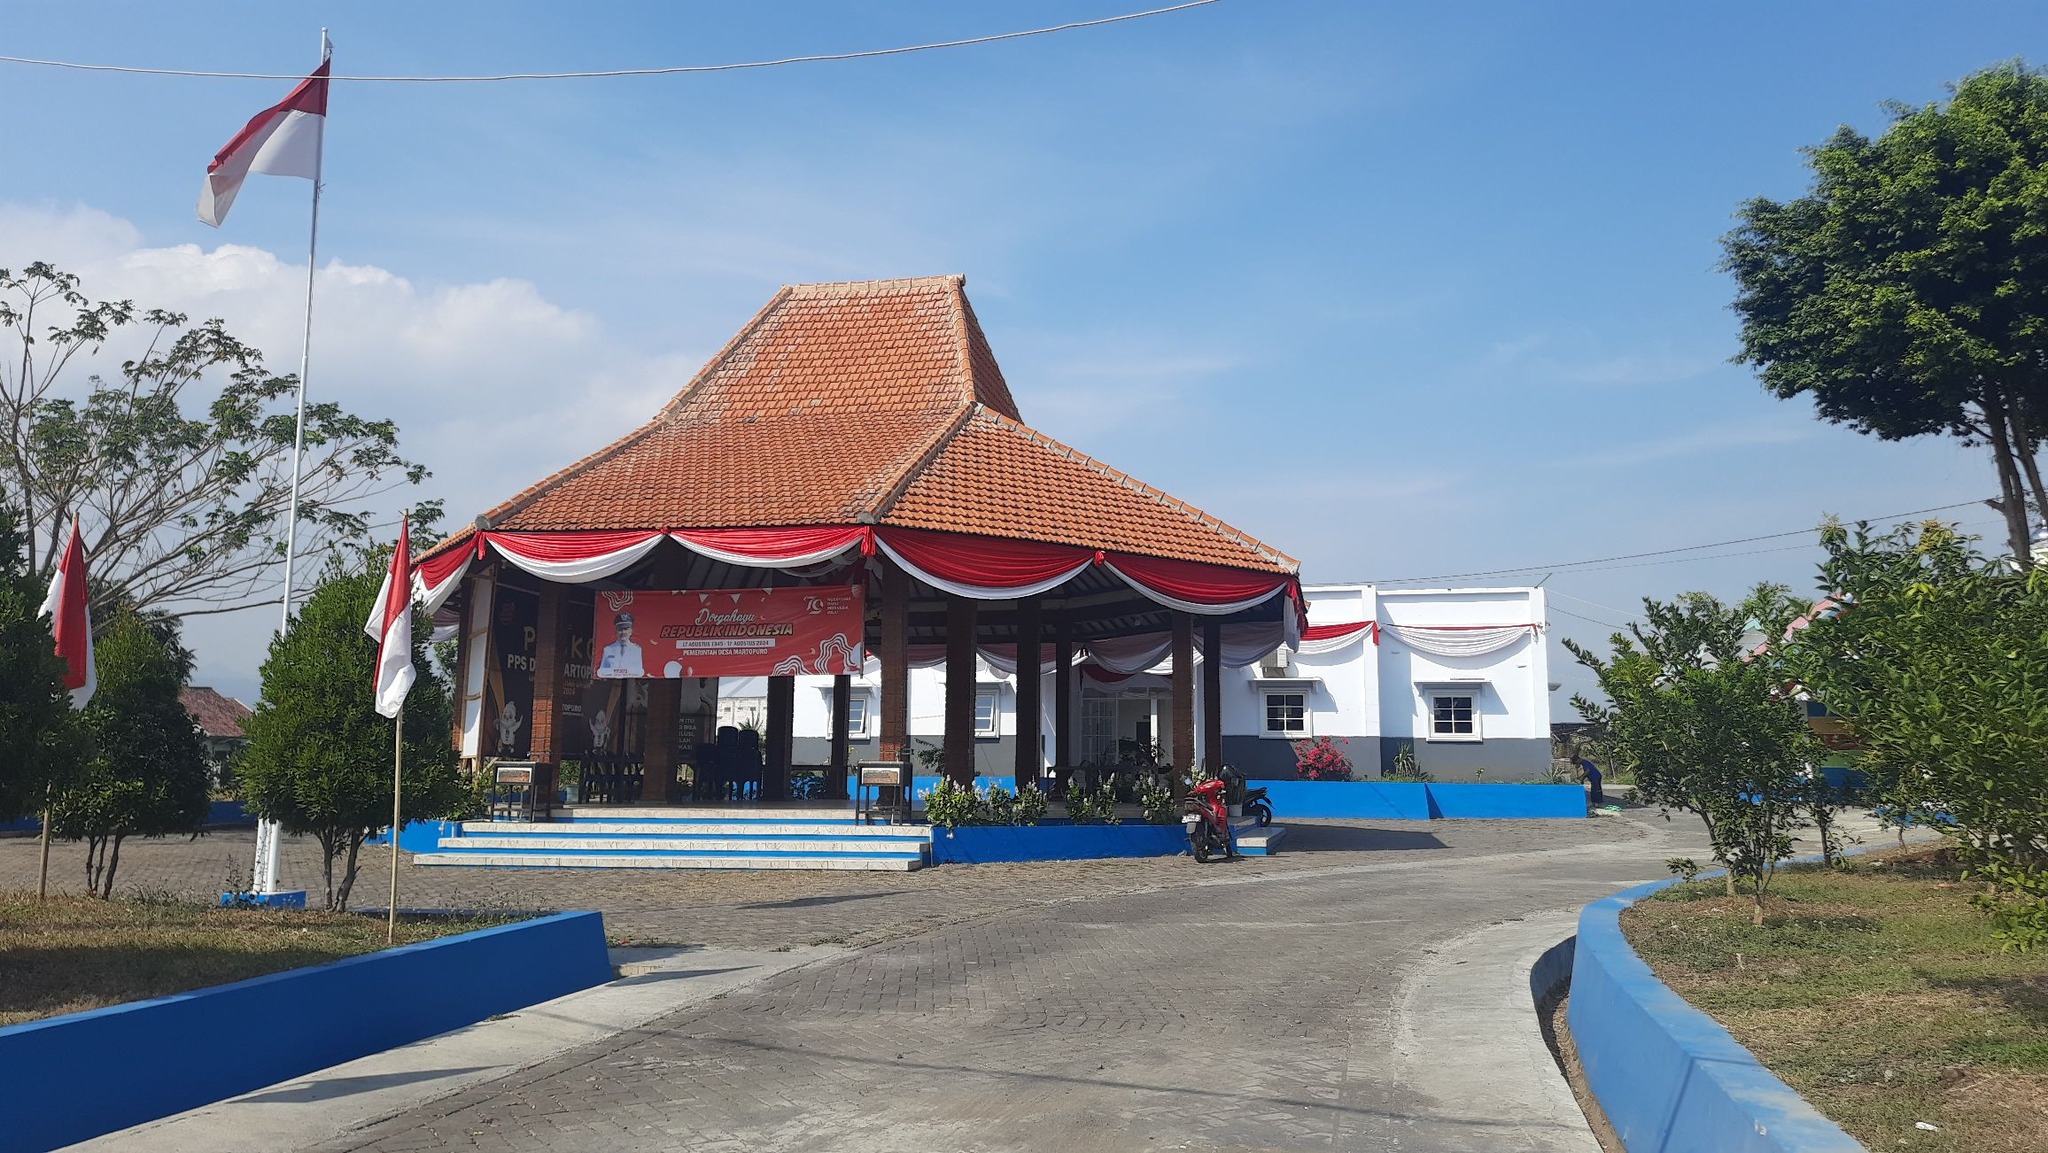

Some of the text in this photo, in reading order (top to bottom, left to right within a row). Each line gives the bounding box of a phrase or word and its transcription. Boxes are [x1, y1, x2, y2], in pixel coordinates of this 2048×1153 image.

[660, 624, 793, 638] REPUBLIK INDONESIA
[506, 653, 527, 671] PPS
